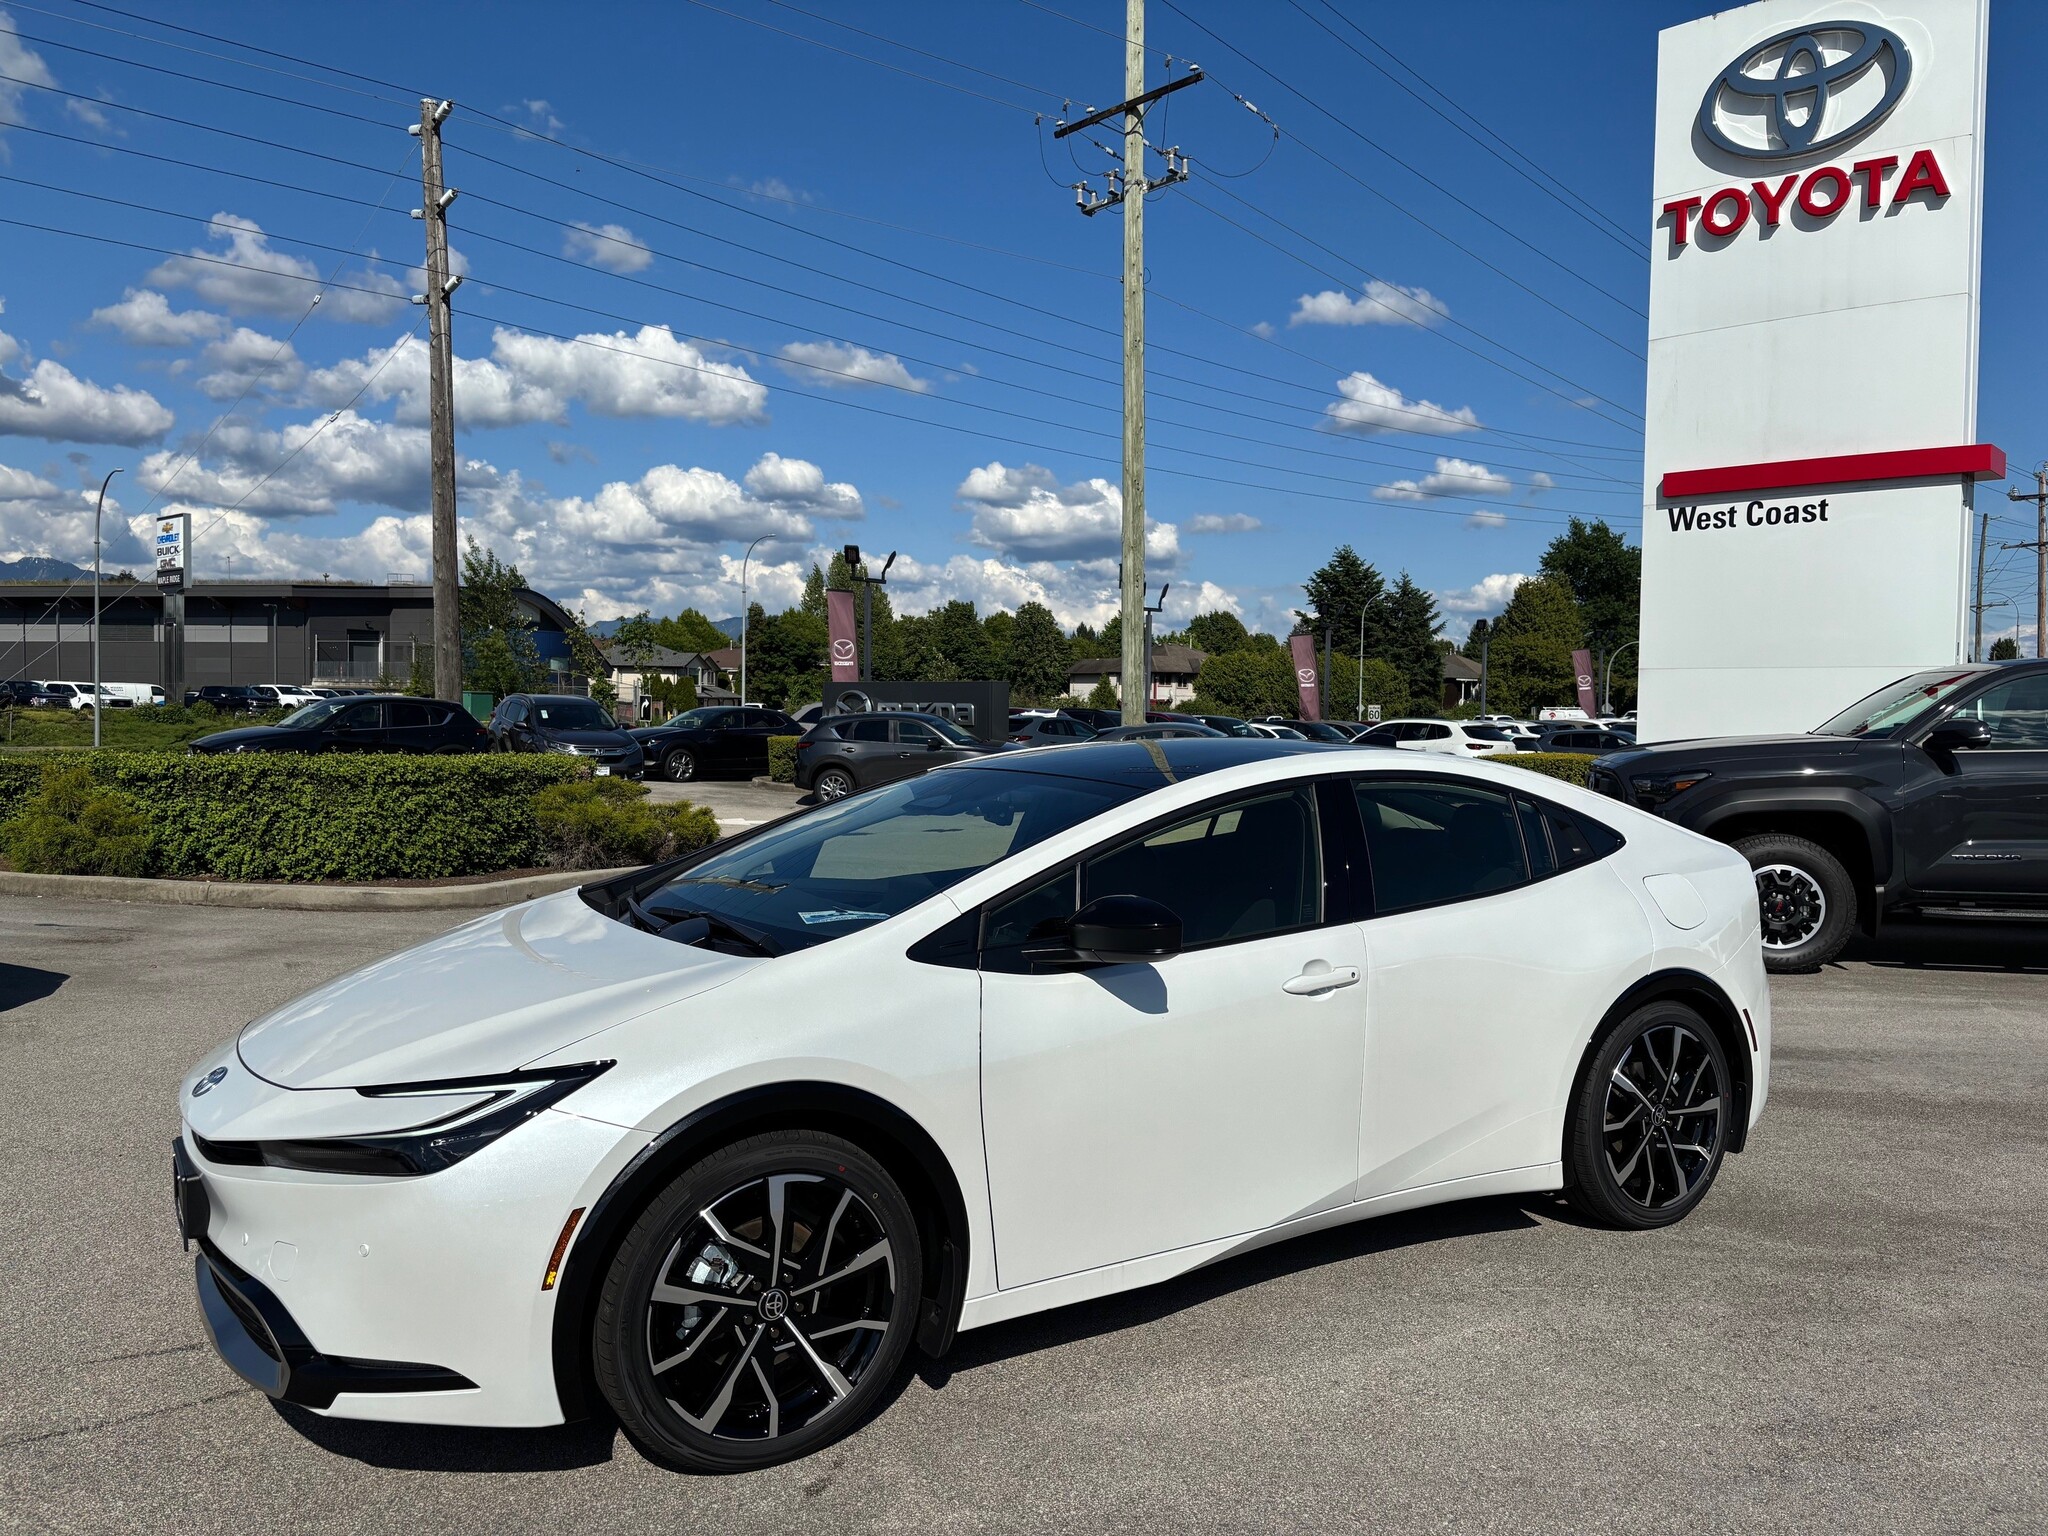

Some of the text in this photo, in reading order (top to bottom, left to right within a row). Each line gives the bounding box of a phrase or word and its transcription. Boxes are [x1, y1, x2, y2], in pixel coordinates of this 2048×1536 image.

[1664, 149, 1952, 247] TOYOTA
[1667, 499, 1829, 531] West Coast
[157, 545, 180, 557] BUICK
[157, 574, 180, 585] MAPLE RIDGE
[1369, 710, 1380, 720] 60
